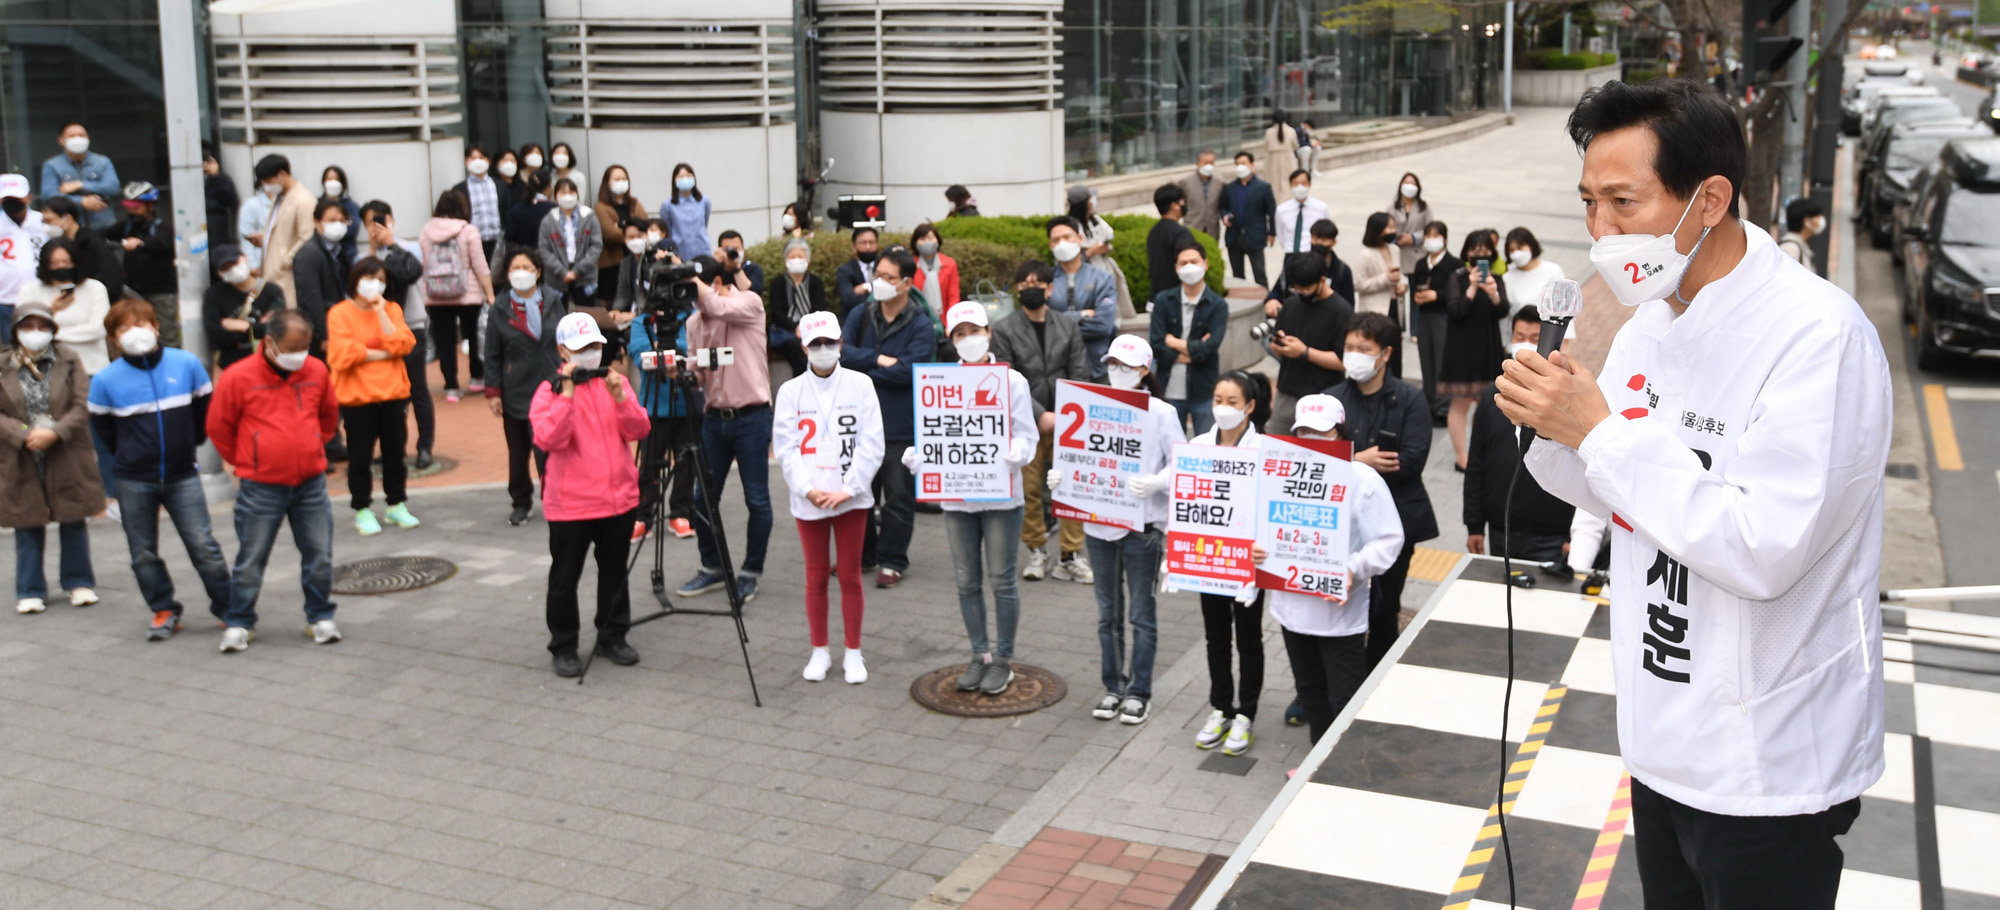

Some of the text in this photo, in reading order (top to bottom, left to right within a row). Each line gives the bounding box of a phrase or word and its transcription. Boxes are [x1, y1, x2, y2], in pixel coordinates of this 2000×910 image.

[0, 238, 16, 260] 2
[1623, 262, 1651, 285] 2 번
[1646, 264, 1665, 277] 오세훈
[577, 319, 591, 335] 2
[922, 384, 963, 409] 이번
[798, 418, 817, 455] 2
[922, 414, 1005, 438] 보궐선거
[1059, 402, 1086, 450] 2
[922, 442, 999, 465] 왜 하죠?
[1088, 433, 1142, 459] 오세훈
[1263, 458, 1326, 481] 투표가 곧
[1282, 479, 1347, 502] 국민의 힘
[1176, 502, 1234, 527] 답해요!
[1271, 502, 1336, 527] 사전투표
[1286, 565, 1299, 589] 2
[1301, 574, 1344, 596] 오세훈
